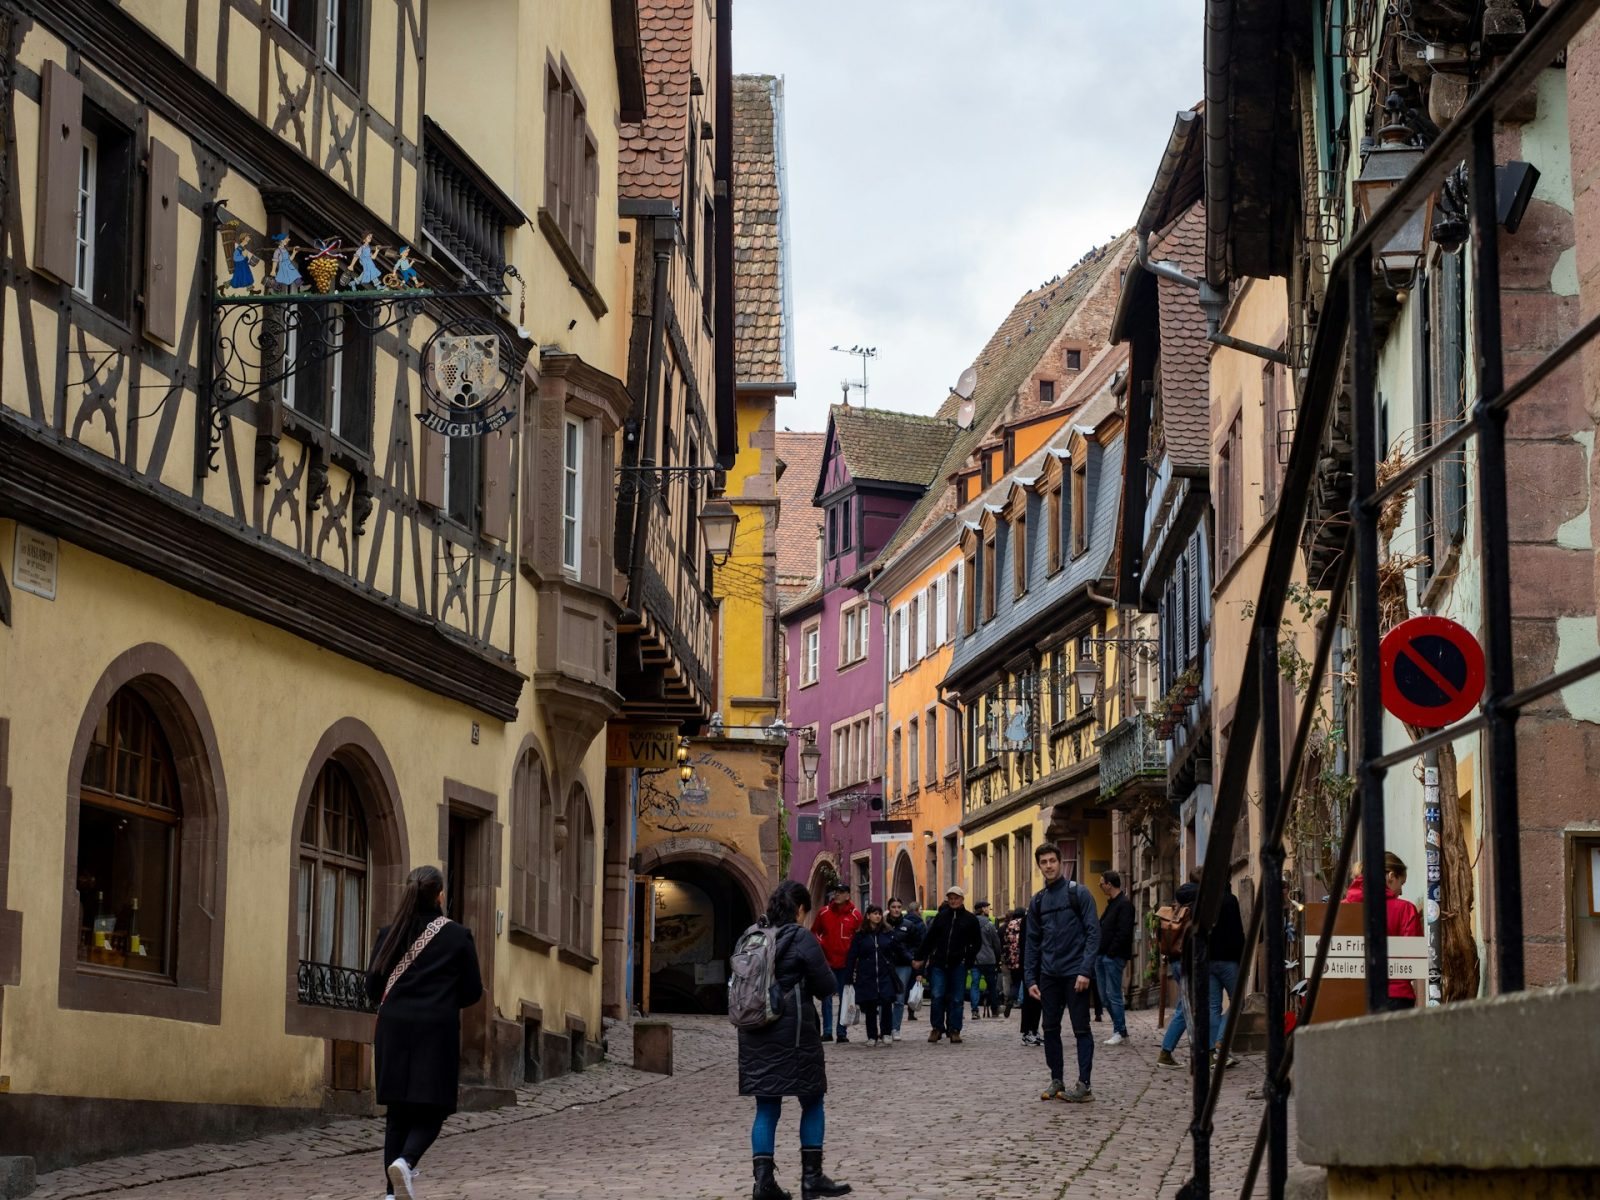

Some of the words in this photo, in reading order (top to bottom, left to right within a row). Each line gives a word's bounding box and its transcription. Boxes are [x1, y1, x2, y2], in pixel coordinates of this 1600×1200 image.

[629, 732, 674, 740] BOUTIQUE
[629, 741, 674, 761] VINI
[1331, 961, 1357, 973] Atelier
